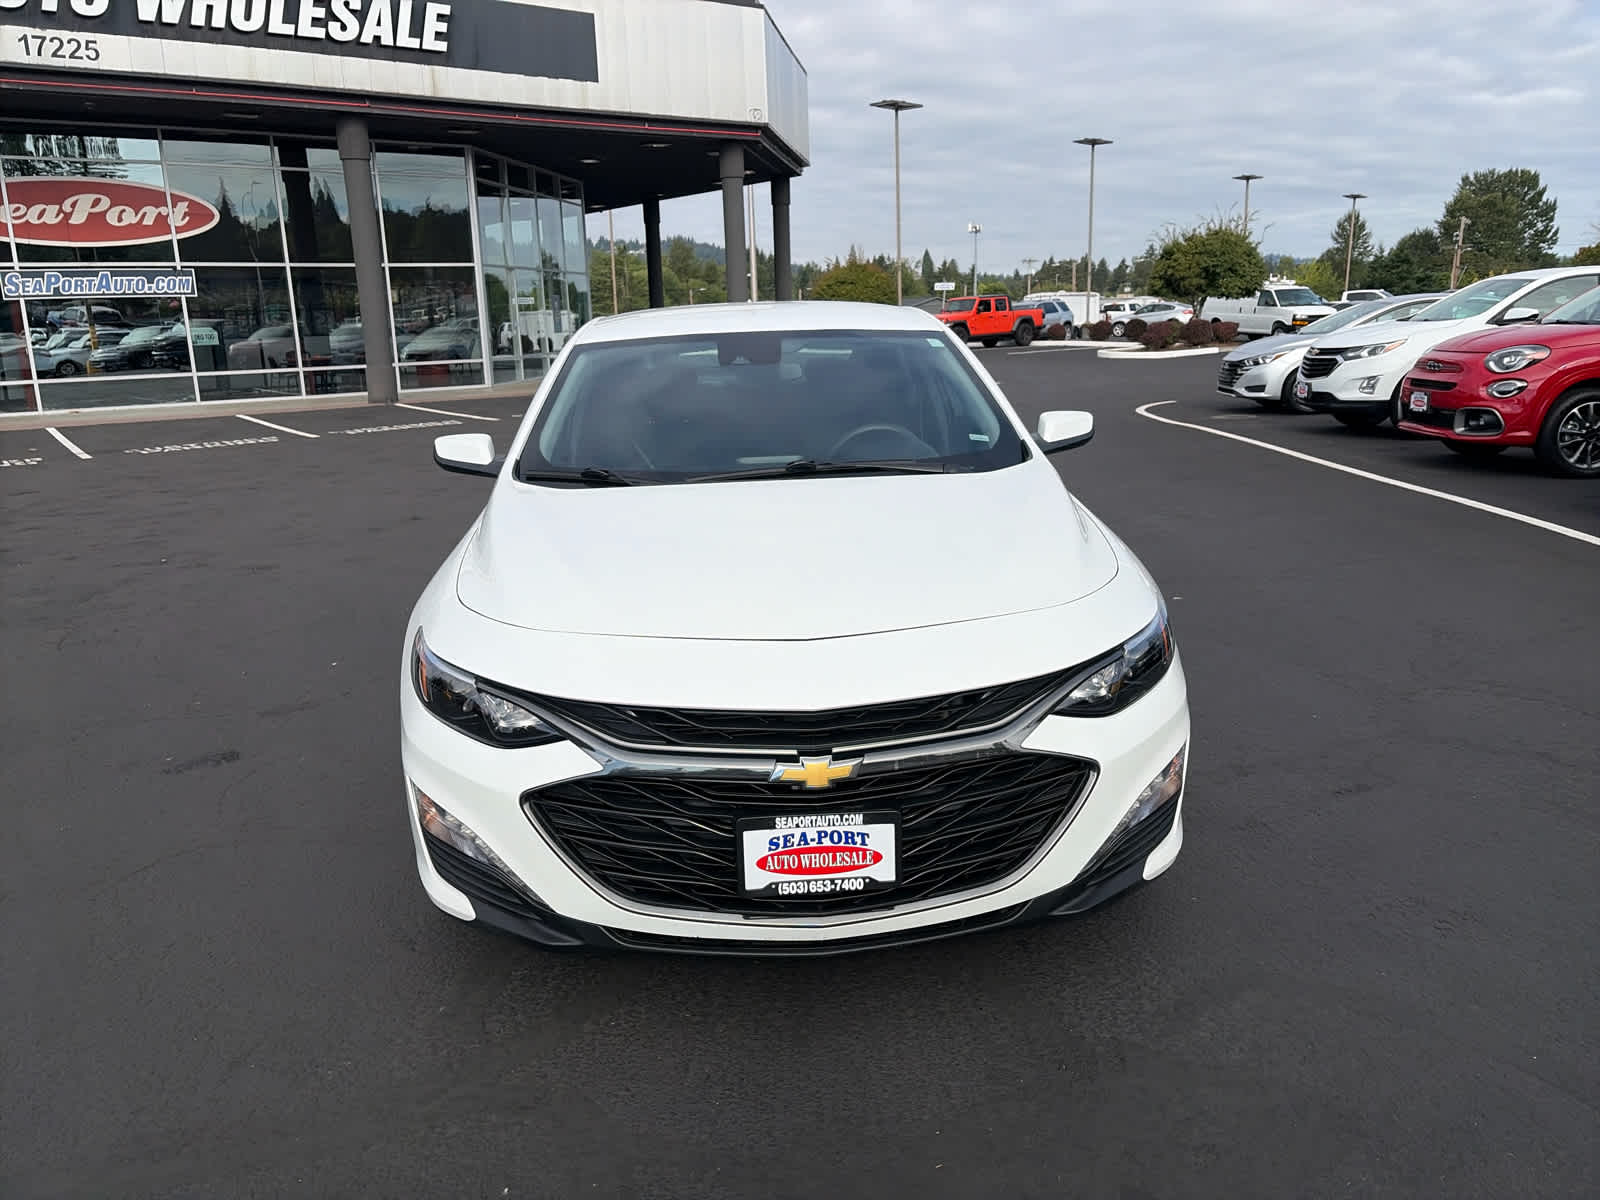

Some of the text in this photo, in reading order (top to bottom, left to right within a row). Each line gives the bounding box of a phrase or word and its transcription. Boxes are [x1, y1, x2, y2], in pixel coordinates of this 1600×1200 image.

[17, 33, 100, 61] 17225
[0, 193, 190, 227] eaPort
[775, 814, 863, 829] SEAPORTAUTO.COM
[768, 830, 869, 852] SEA-PORT
[765, 850, 874, 871] AUTO WHOLESALE
